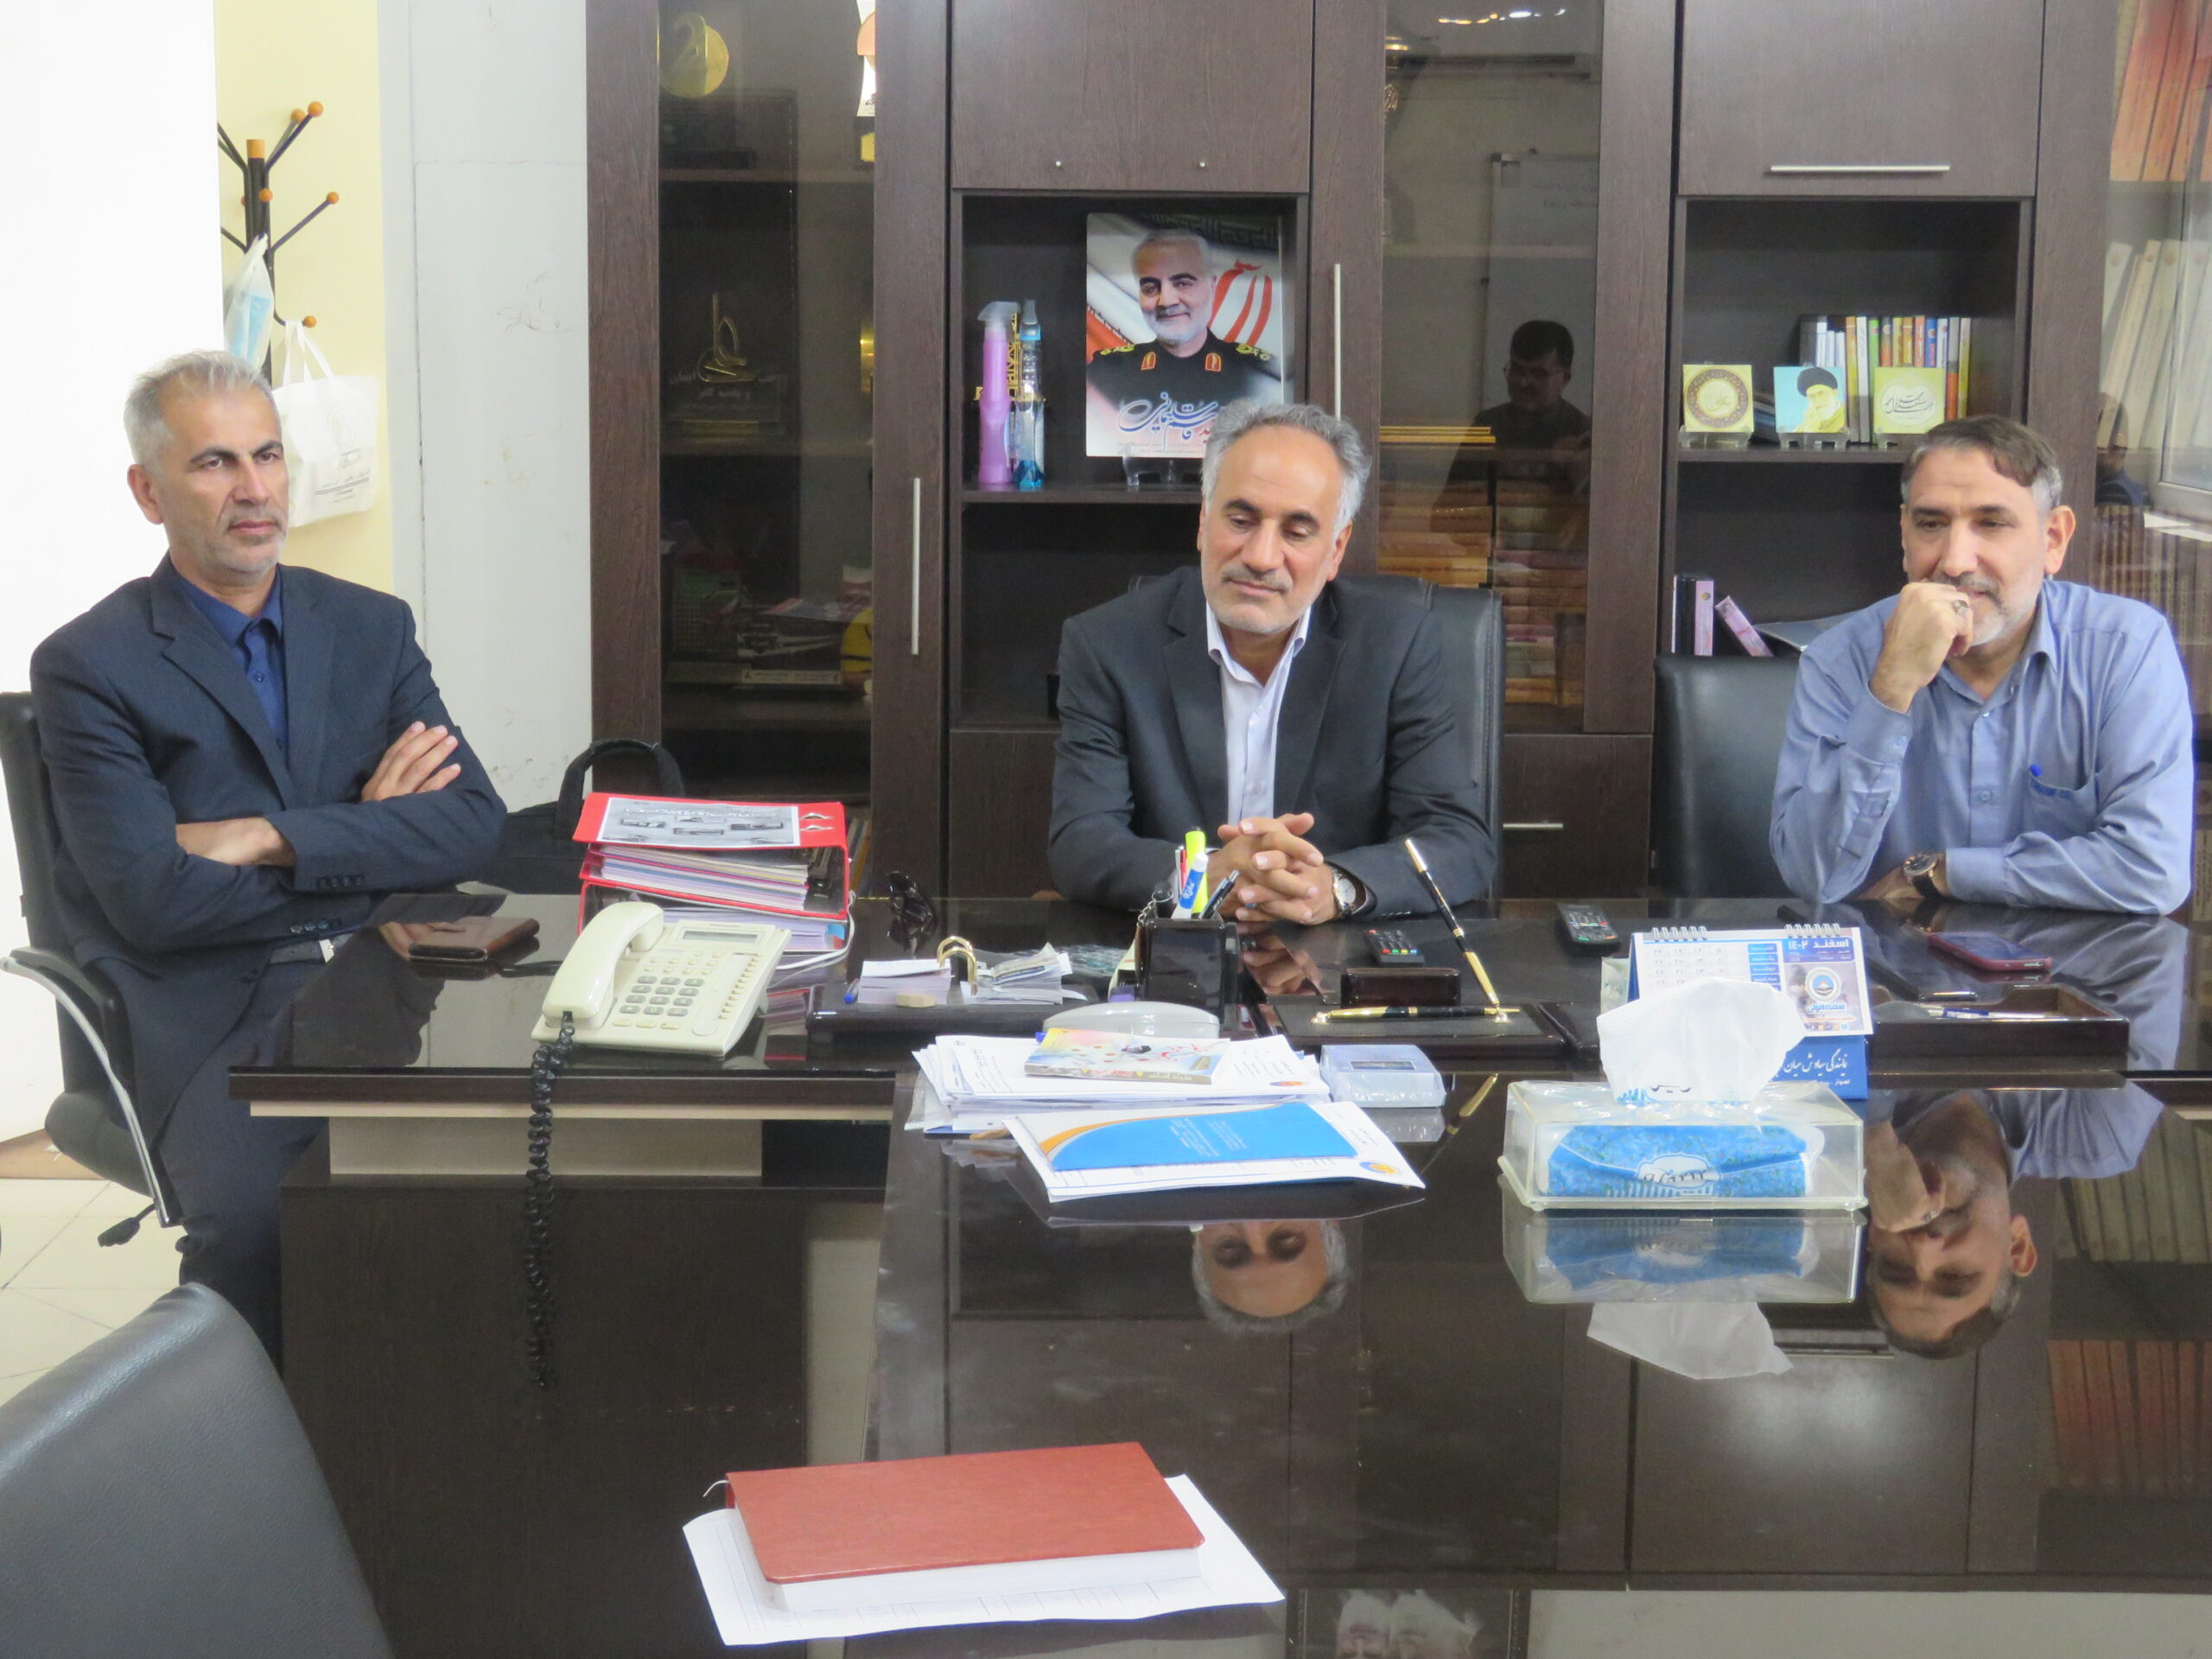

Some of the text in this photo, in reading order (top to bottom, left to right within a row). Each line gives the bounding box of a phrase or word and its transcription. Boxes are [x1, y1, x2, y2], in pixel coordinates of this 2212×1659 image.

[1118, 391, 1217, 432] سلیمانی
[1812, 938, 1849, 949] اسفند
[1802, 1052, 1826, 1077] سیاوش
[1825, 1047, 1848, 1077] نمایندگی
